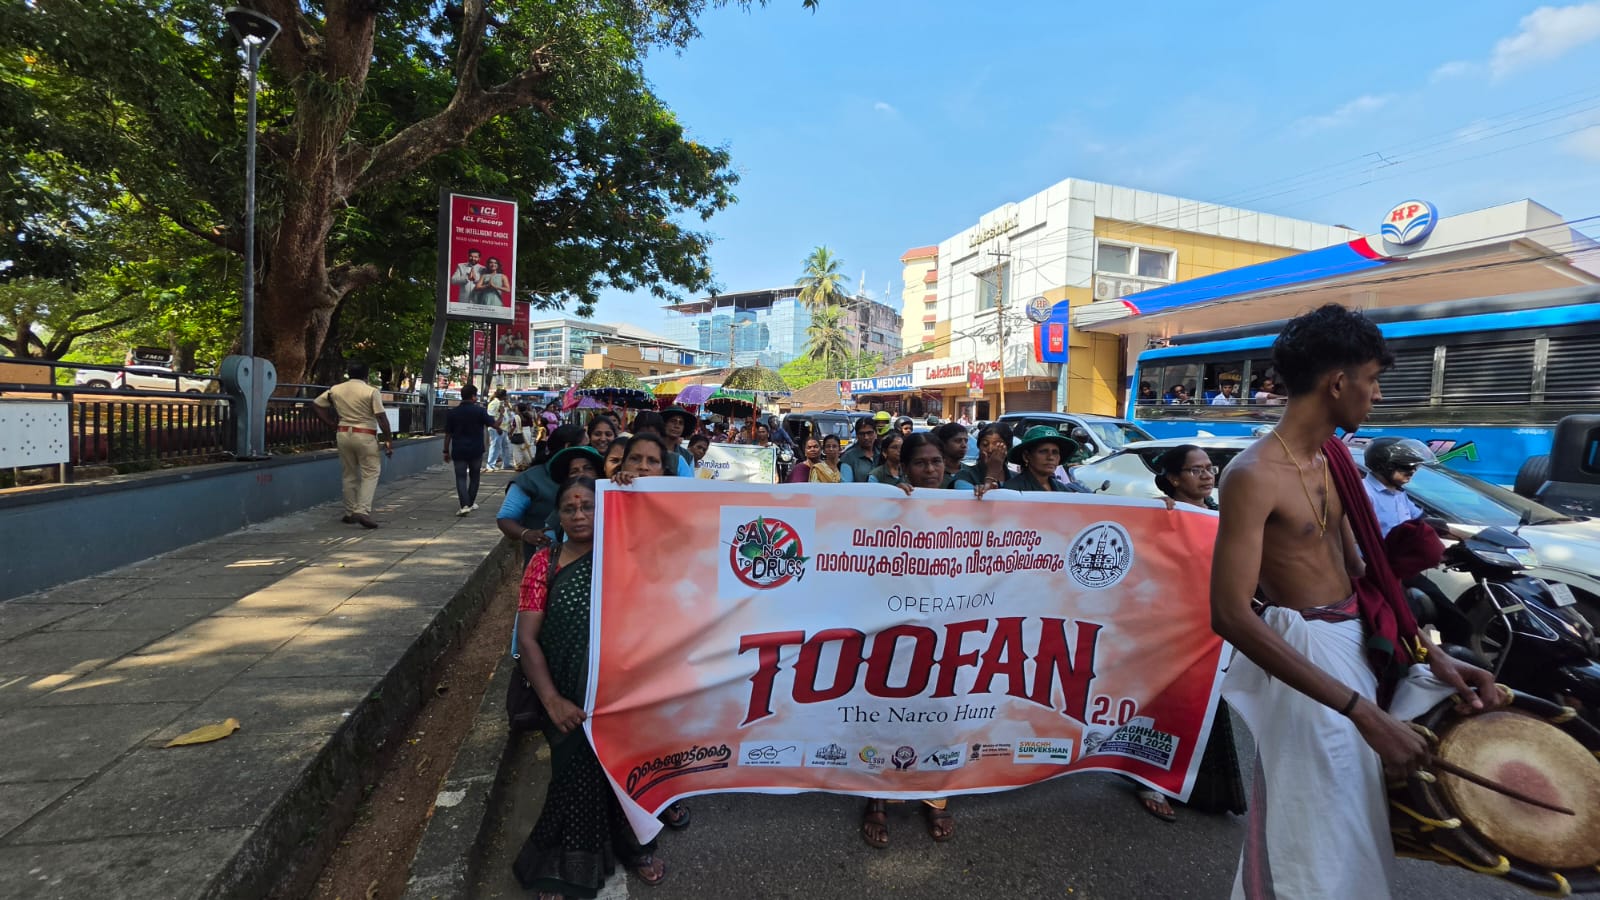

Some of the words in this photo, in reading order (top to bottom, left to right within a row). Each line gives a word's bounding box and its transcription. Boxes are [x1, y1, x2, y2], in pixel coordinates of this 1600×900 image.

[480, 206, 497, 216] ICL
[1391, 204, 1419, 222] HP
[476, 217, 503, 226] Fincorp
[926, 360, 965, 380] Lakshmi
[851, 380, 874, 391] ETHA
[737, 522, 780, 544] SAY
[986, 530, 1042, 552] പോരാട്ടം
[752, 557, 802, 579] DRUGS
[887, 592, 996, 614] OPERATION
[738, 616, 1104, 728] TOOFAN
[1091, 697, 1137, 727] 2.0
[838, 706, 880, 723] The
[888, 707, 948, 723] Narco
[953, 704, 997, 722] Hunt
[1115, 733, 1142, 743] SEVA
[1144, 738, 1173, 753] 2026
